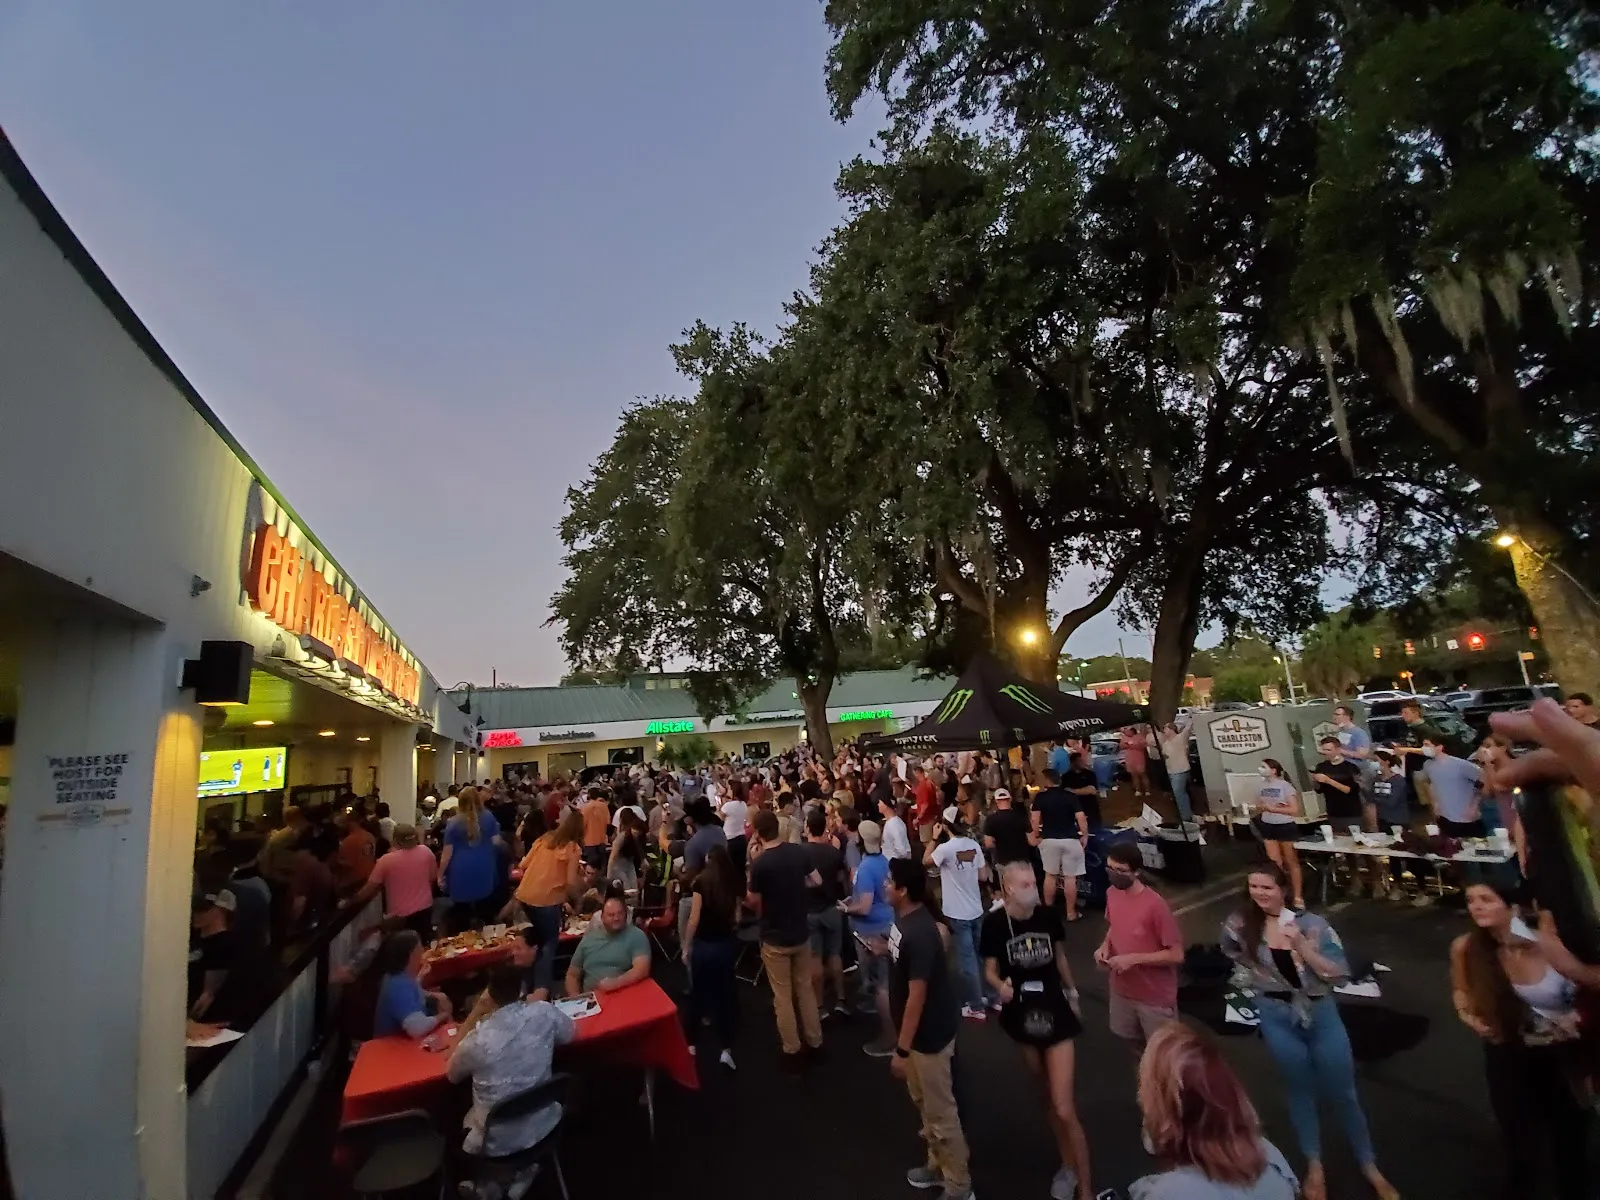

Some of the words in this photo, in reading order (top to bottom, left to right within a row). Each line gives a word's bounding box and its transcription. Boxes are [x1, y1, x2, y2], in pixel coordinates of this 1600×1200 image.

[840, 711, 876, 722] GATHERING
[645, 720, 695, 735] Allstate
[1217, 733, 1263, 743] CHARLESTON
[49, 756, 102, 768] PLEASE
[104, 753, 129, 765] SEE
[95, 766, 123, 778] FOR
